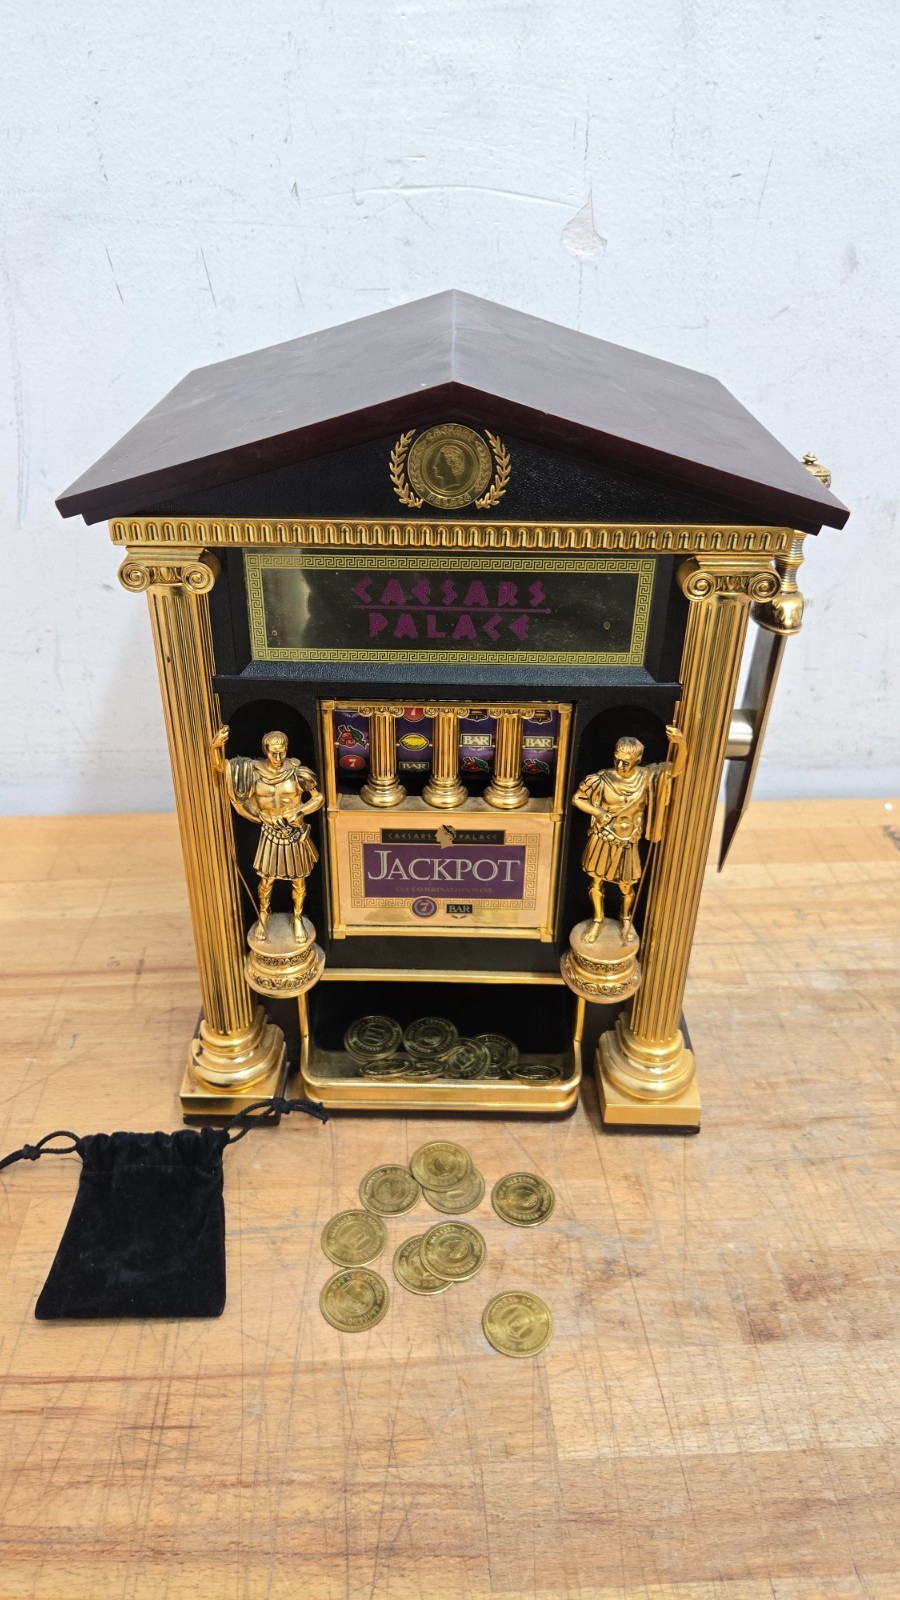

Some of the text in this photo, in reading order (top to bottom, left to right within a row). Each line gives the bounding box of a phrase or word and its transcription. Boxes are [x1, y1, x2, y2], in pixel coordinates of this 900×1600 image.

[352, 576, 546, 606] CAESARS
[368, 612, 529, 641] PALACE
[463, 735, 490, 747] BAR
[525, 738, 552, 748] BAR
[348, 759, 356, 768] 7
[402, 762, 427, 770] BAR
[368, 850, 520, 882] JACKPOT
[420, 902, 429, 912] 7
[448, 905, 470, 913] BAR
